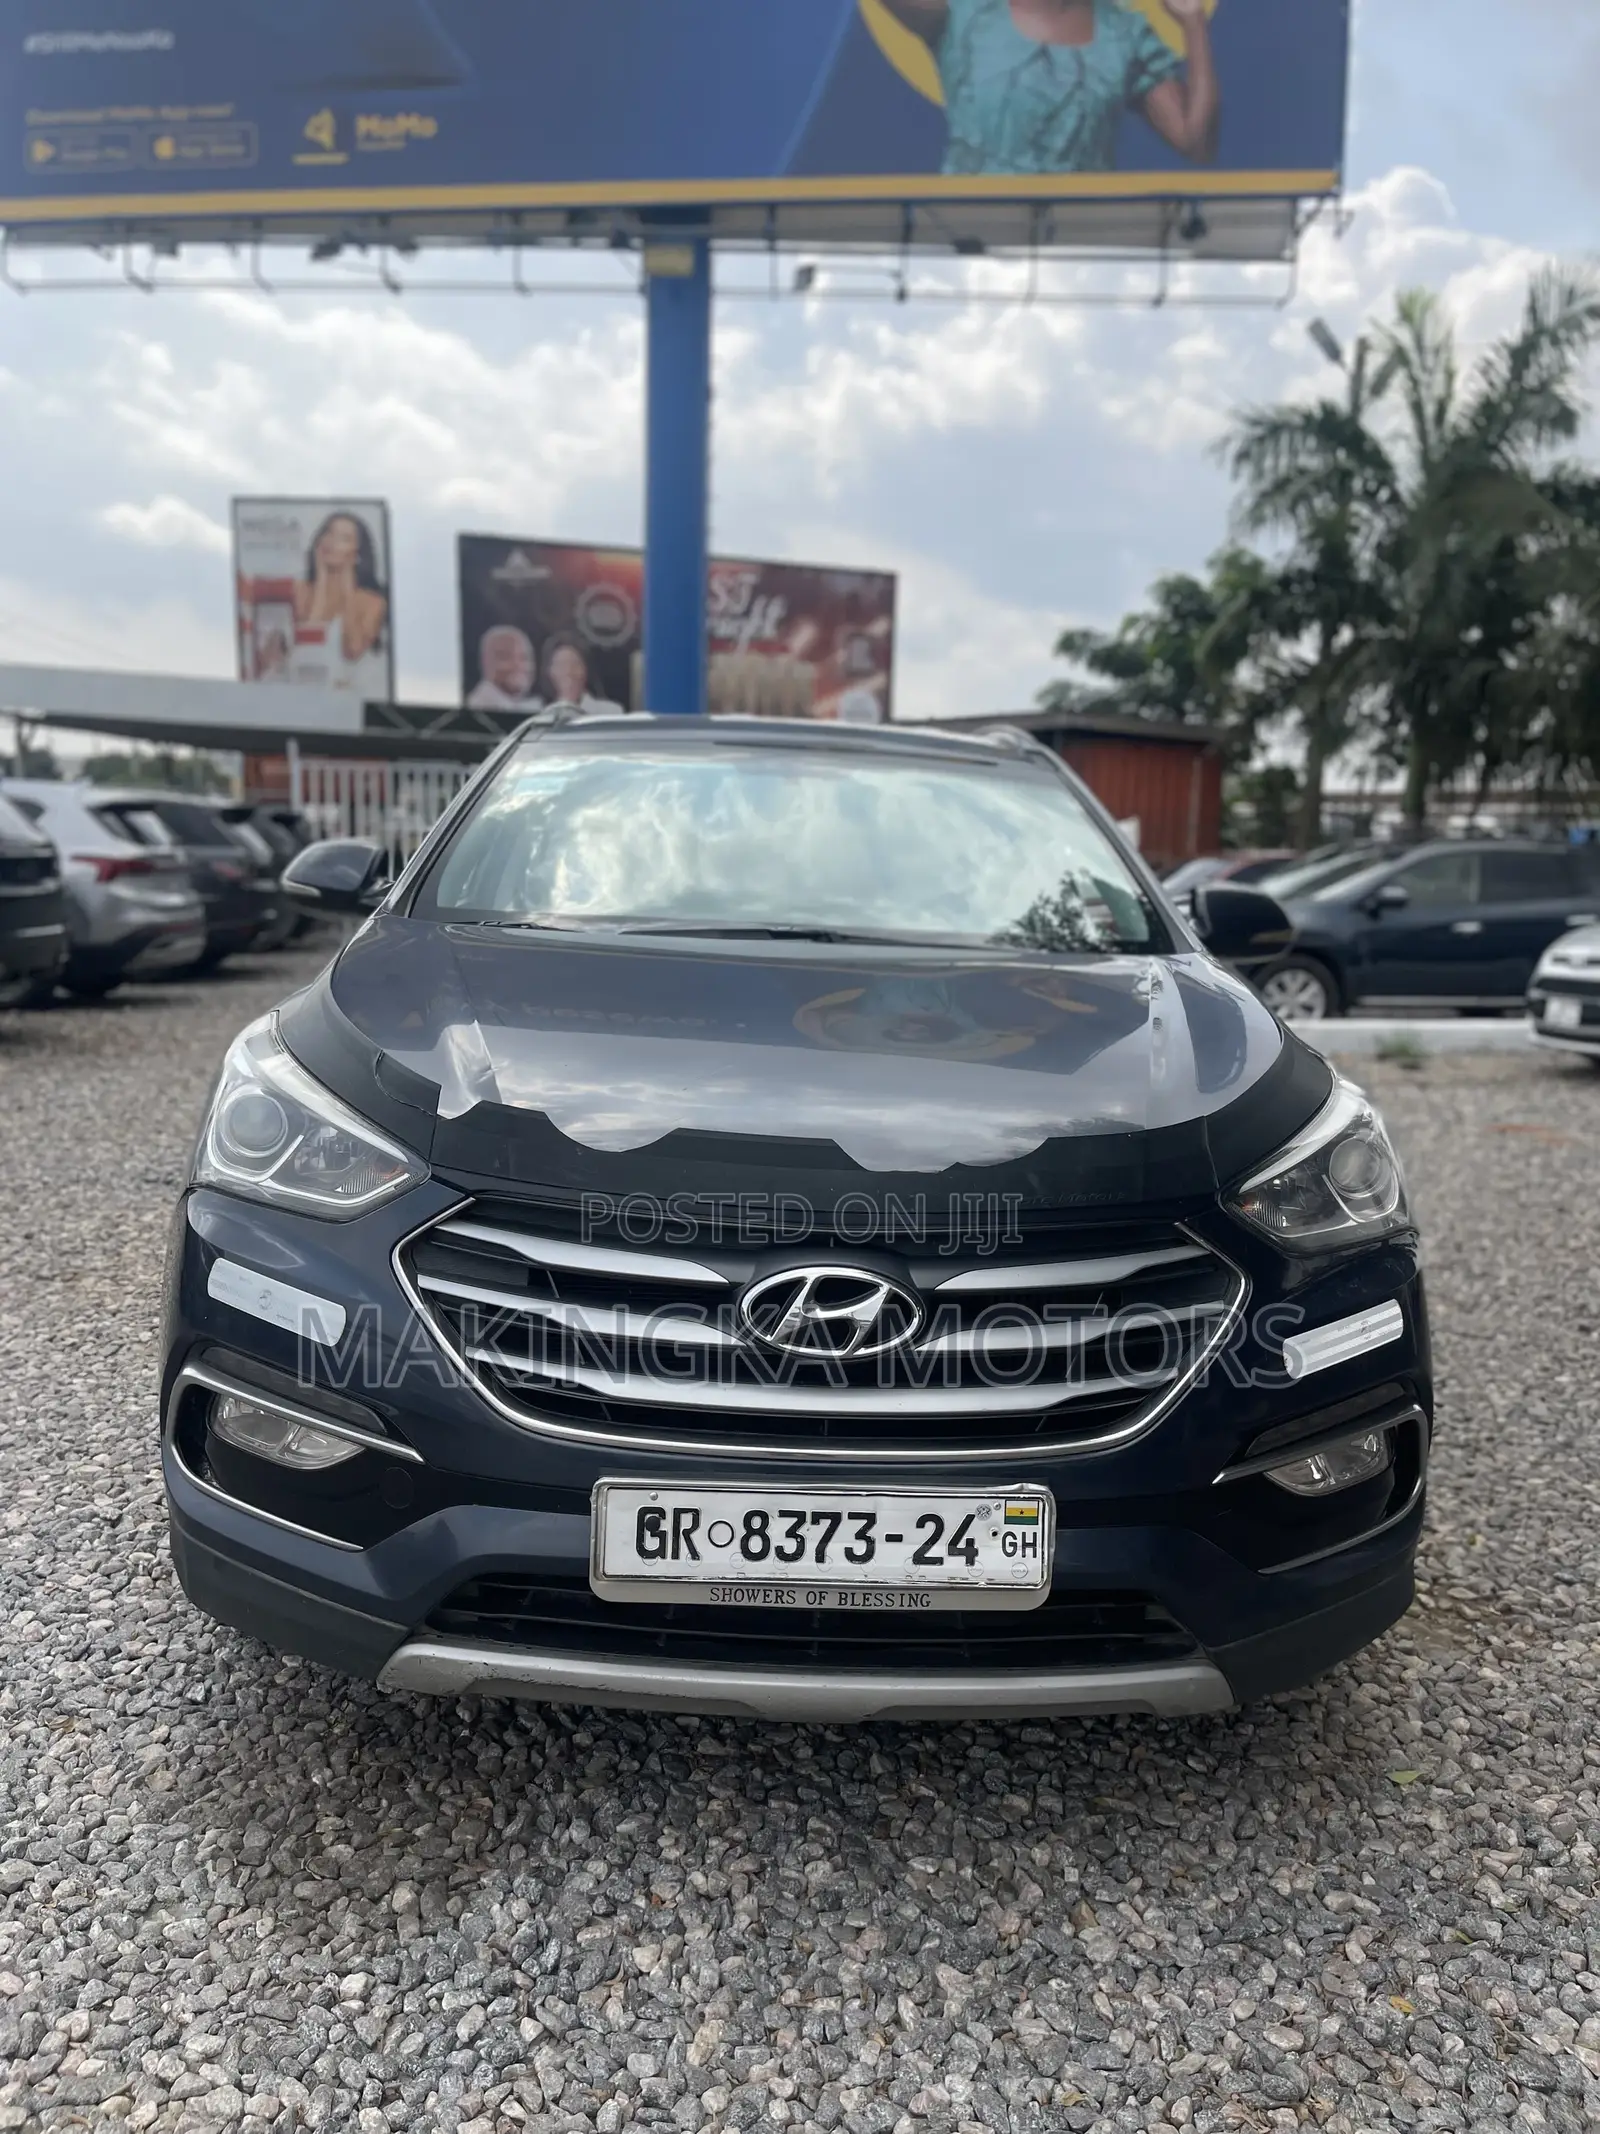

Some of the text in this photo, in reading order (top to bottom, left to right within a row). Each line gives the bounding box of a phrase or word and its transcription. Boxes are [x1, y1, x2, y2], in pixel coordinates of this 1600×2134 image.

[635, 1506, 979, 1567] GR 8373-24
[1002, 1531, 1038, 1559] GH
[709, 1586, 932, 1608] SHOWERS OF BLESSING
